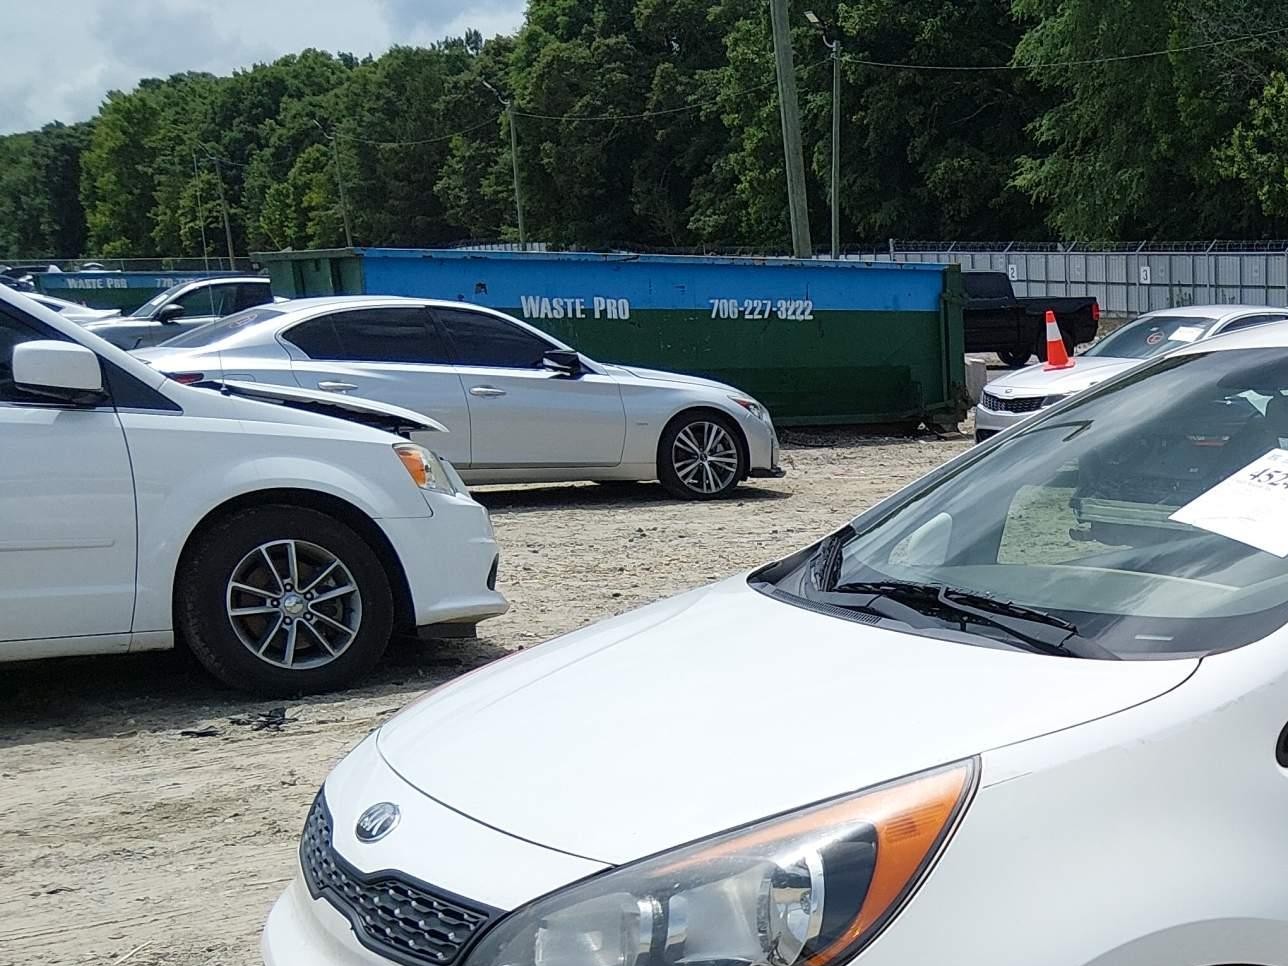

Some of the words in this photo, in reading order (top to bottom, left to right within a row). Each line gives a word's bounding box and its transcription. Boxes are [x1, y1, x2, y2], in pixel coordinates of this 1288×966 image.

[520, 295, 586, 319] WASTE
[593, 296, 630, 320] PRO
[709, 299, 815, 321] 706-227-3222
